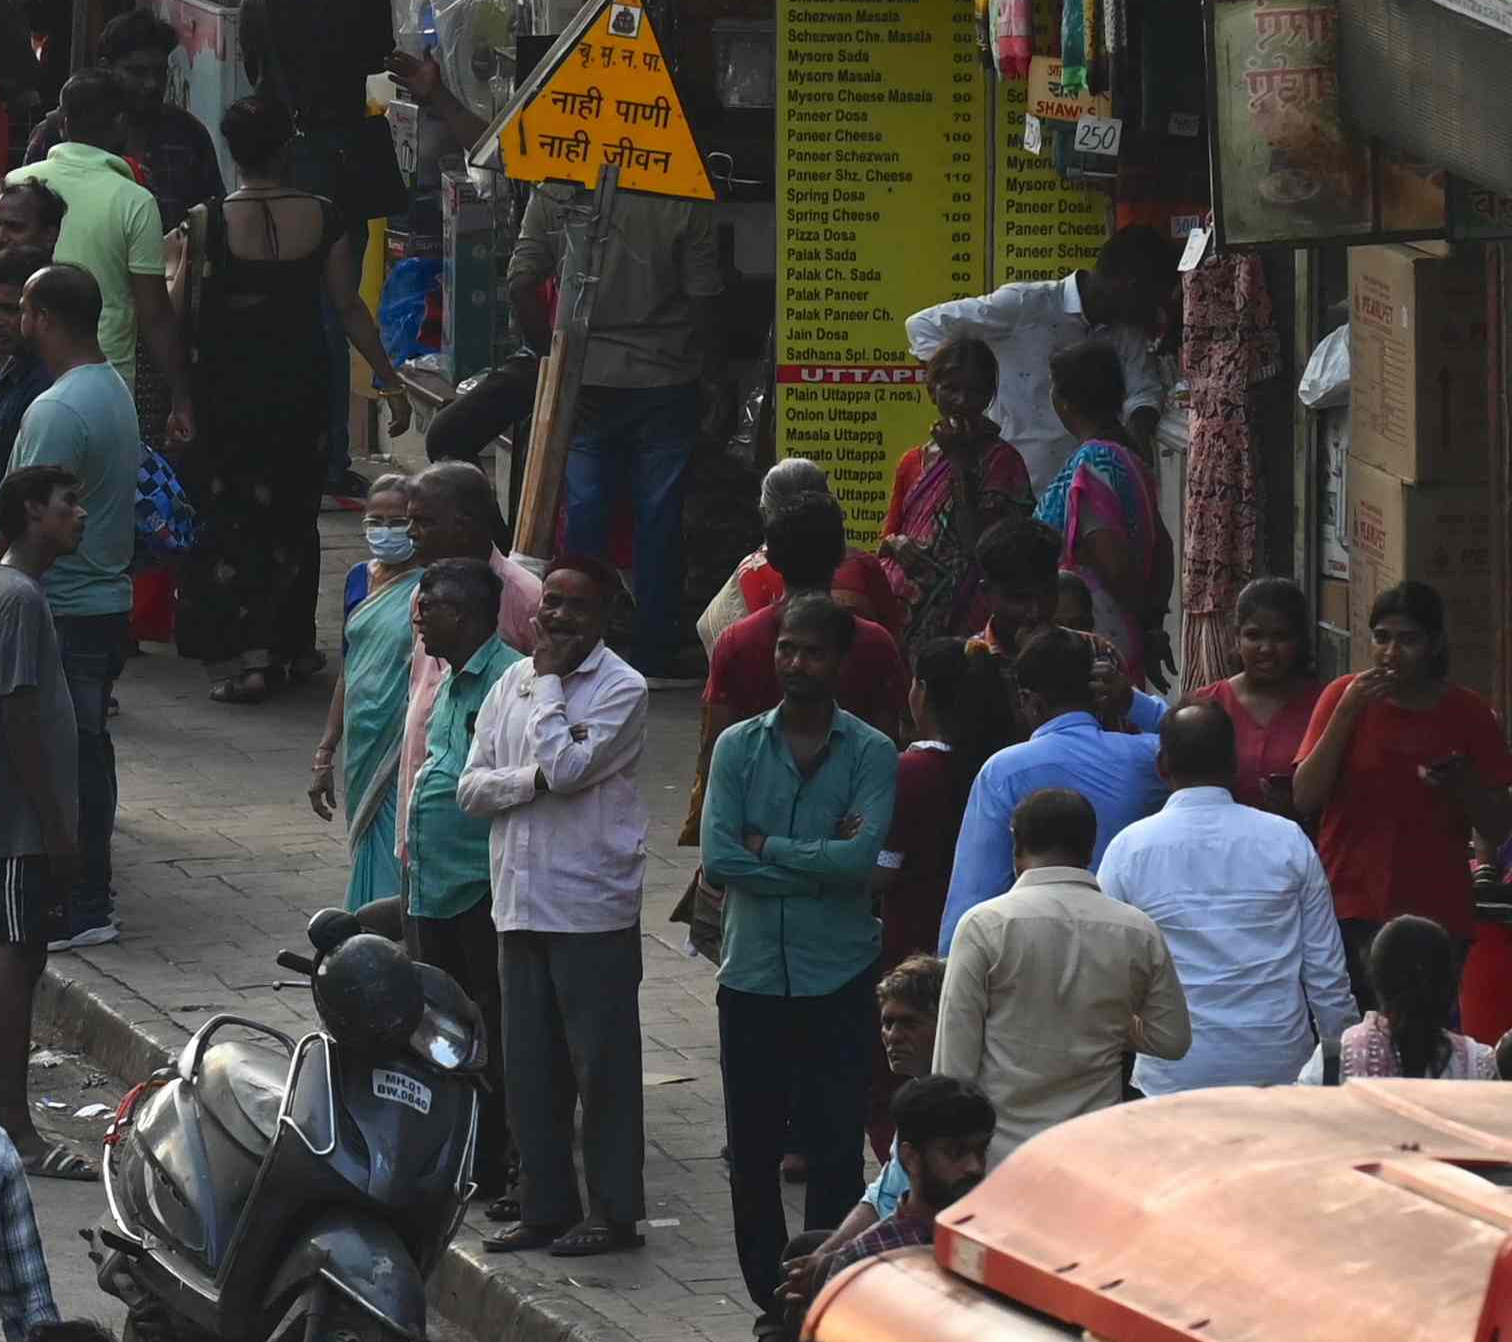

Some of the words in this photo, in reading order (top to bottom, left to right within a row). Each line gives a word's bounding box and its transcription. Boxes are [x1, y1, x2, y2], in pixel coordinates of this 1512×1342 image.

[788, 10, 853, 23] Schezwan
[856, 10, 900, 23] Masala
[788, 30, 852, 43] Schezwan
[887, 30, 932, 43] Masala
[621, 49, 637, 70] न.
[643, 51, 662, 73] पा.
[788, 50, 830, 65] Mysore
[833, 50, 869, 65] Sada
[788, 71, 834, 86] Mysore
[838, 71, 882, 86] Masala
[788, 90, 834, 105] Mysore
[838, 90, 884, 105] Cheese
[887, 90, 932, 105] Masala
[551, 86, 604, 121] नाही
[616, 96, 672, 129] पाणी
[788, 110, 831, 123] Paneer
[835, 110, 868, 123] Dosa
[788, 130, 831, 143] Paneer
[835, 130, 882, 143] Cheese
[1078, 125, 1116, 150] 250
[538, 130, 591, 163] नाही
[602, 137, 673, 173] जीवन
[788, 150, 831, 163] Paneer
[835, 150, 900, 163] Schezwan
[788, 169, 831, 183] Paneer
[865, 169, 912, 183] Cheese
[1006, 179, 1056, 193] Mysore
[787, 189, 828, 204] Spring
[832, 189, 865, 204] Dosa
[1006, 200, 1053, 213] Paneer
[787, 209, 828, 224] Spring
[832, 209, 880, 224] Cheese
[787, 229, 820, 242] Pizza
[823, 229, 856, 242] Dosa
[1006, 222, 1053, 236] Paneer
[786, 249, 821, 262] Palak
[825, 249, 857, 262] Sada
[1006, 245, 1053, 258] Paneer
[786, 268, 821, 282] Palak
[825, 268, 846, 282] Ch.
[850, 268, 881, 282] Sada
[786, 288, 821, 301] Palak
[824, 288, 869, 301] Paneer
[786, 308, 821, 322] Palak
[824, 308, 869, 322] Paneer
[872, 308, 894, 322] Ch.
[786, 328, 813, 341] Jain
[816, 328, 848, 341] Dosa
[786, 348, 842, 361] Sadhana
[845, 348, 868, 364] Spl.
[873, 348, 905, 361] Dosa
[786, 388, 820, 401] Plain
[822, 388, 871, 405] Uttappa
[874, 388, 886, 404] (2
[889, 388, 921, 404] nos.)
[786, 408, 825, 421] Onion
[828, 408, 877, 425] Uttappa
[786, 428, 830, 441] Masala
[834, 428, 883, 445] Uttappa
[786, 448, 832, 461] Tomato
[836, 448, 886, 464] Uttappa
[834, 468, 882, 483] Uttappa
[837, 488, 886, 504] Uttappa
[385, 1074, 422, 1095] MH.01
